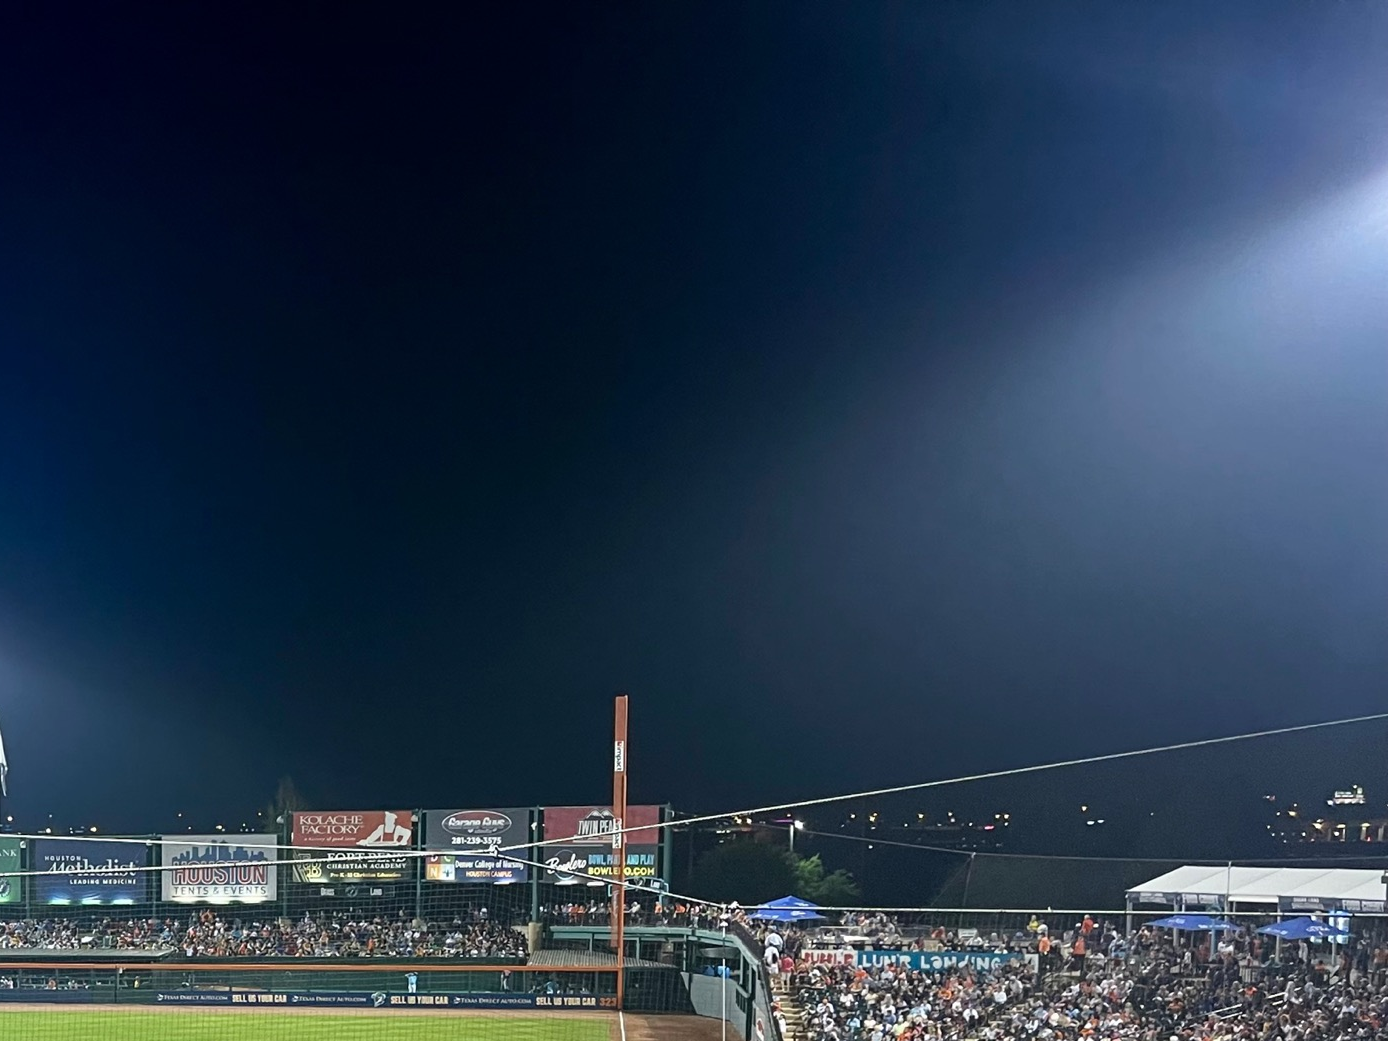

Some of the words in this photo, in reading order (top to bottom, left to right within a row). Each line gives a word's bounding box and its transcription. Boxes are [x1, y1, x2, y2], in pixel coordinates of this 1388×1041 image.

[300, 815, 363, 825] KOLACHE
[301, 825, 360, 834] FACTORY
[578, 820, 598, 835] TWIN
[452, 836, 501, 844] 281-239-3575
[48, 859, 136, 876] Methodist
[455, 860, 473, 868] Denver
[546, 853, 587, 874] Bowlero
[173, 860, 268, 885] HOUSTON
[174, 887, 209, 895] TENTS
[213, 887, 220, 895] &
[223, 886, 267, 895] EVENTS
[232, 994, 247, 1003] SELL
[248, 994, 256, 1003] US
[257, 994, 273, 1003] YOUR
[274, 995, 287, 1003] CAR
[390, 995, 406, 1004] SELL
[407, 995, 416, 1004] US
[417, 995, 434, 1004] YOUR
[435, 996, 448, 1005] CAR
[535, 997, 552, 1006] SELL
[554, 997, 562, 1006] US
[564, 997, 580, 1006] YOUR
[582, 997, 596, 1006] CAR
